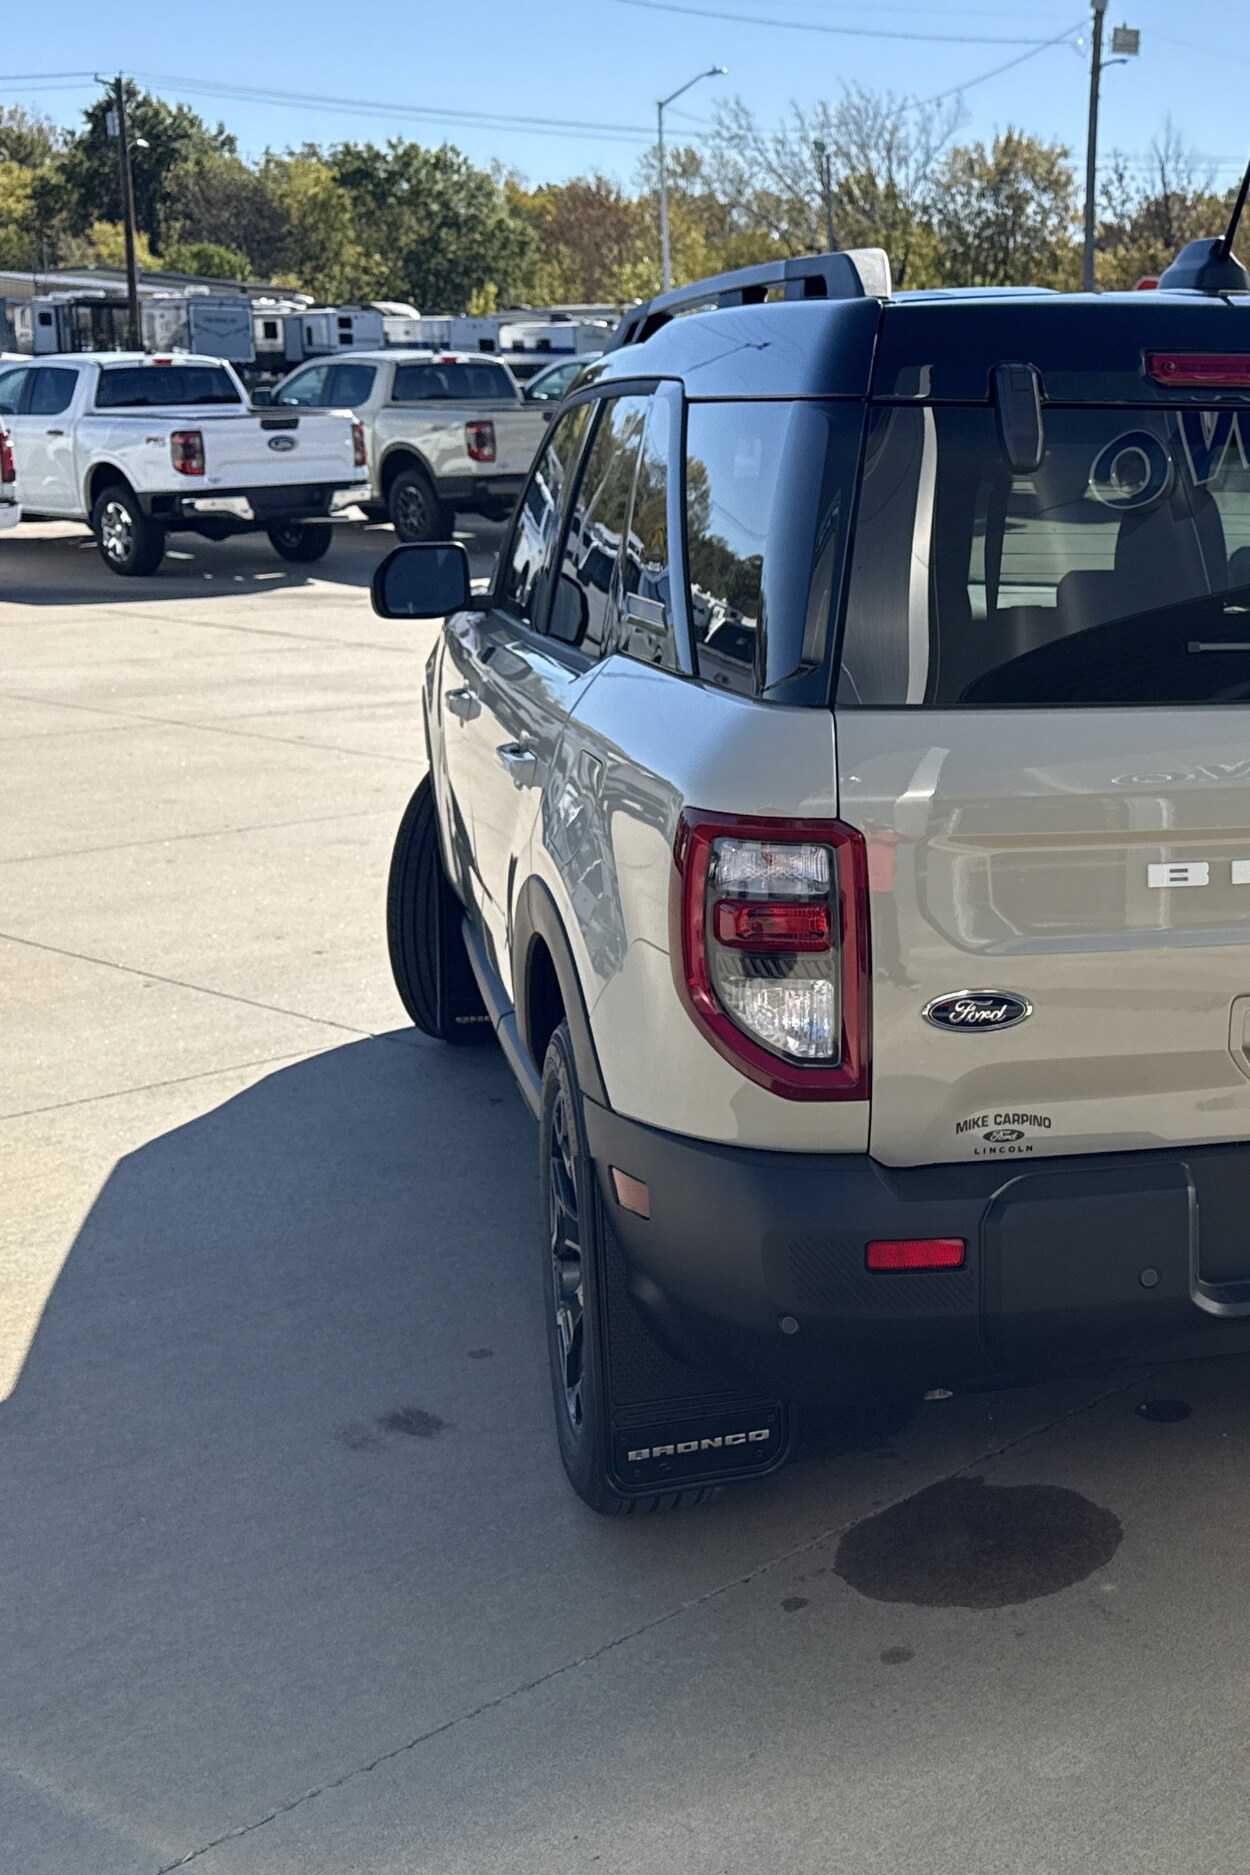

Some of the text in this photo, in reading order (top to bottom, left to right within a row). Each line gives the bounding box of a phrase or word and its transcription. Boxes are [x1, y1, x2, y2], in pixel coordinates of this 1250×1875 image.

[948, 998, 1008, 1024] Ford
[955, 1112, 1052, 1135] MIKE CARPINO
[989, 1129, 1018, 1142] Ford
[973, 1144, 1034, 1156] LINCOLN
[628, 1429, 770, 1461] BRONCO
